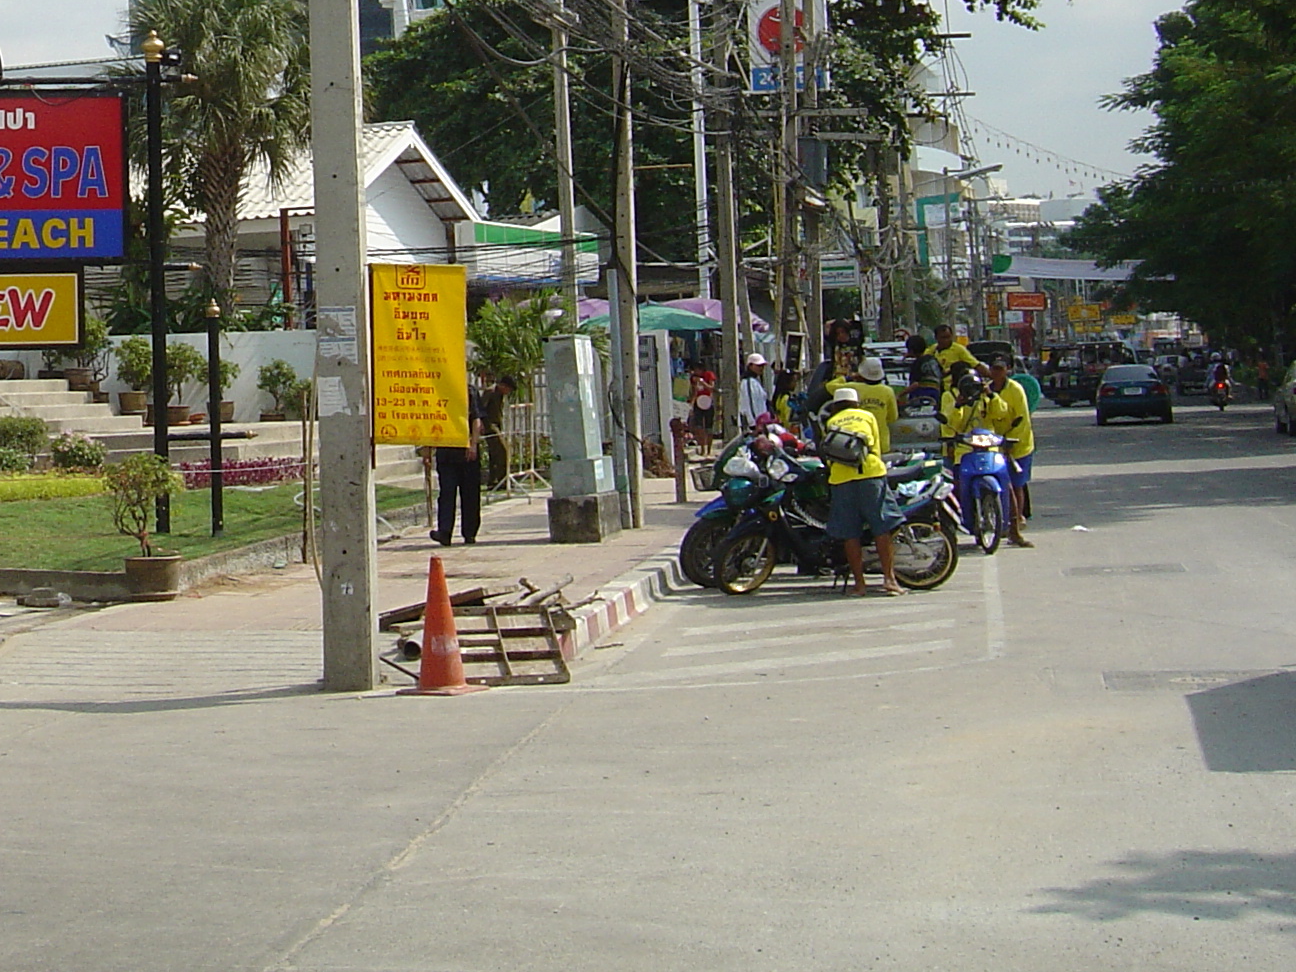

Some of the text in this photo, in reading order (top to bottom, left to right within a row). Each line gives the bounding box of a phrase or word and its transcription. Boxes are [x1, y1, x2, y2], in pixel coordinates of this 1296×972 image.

[21, 146, 108, 198] SPA
[376, 398, 406, 407] 13-23
[436, 399, 449, 408] 47
